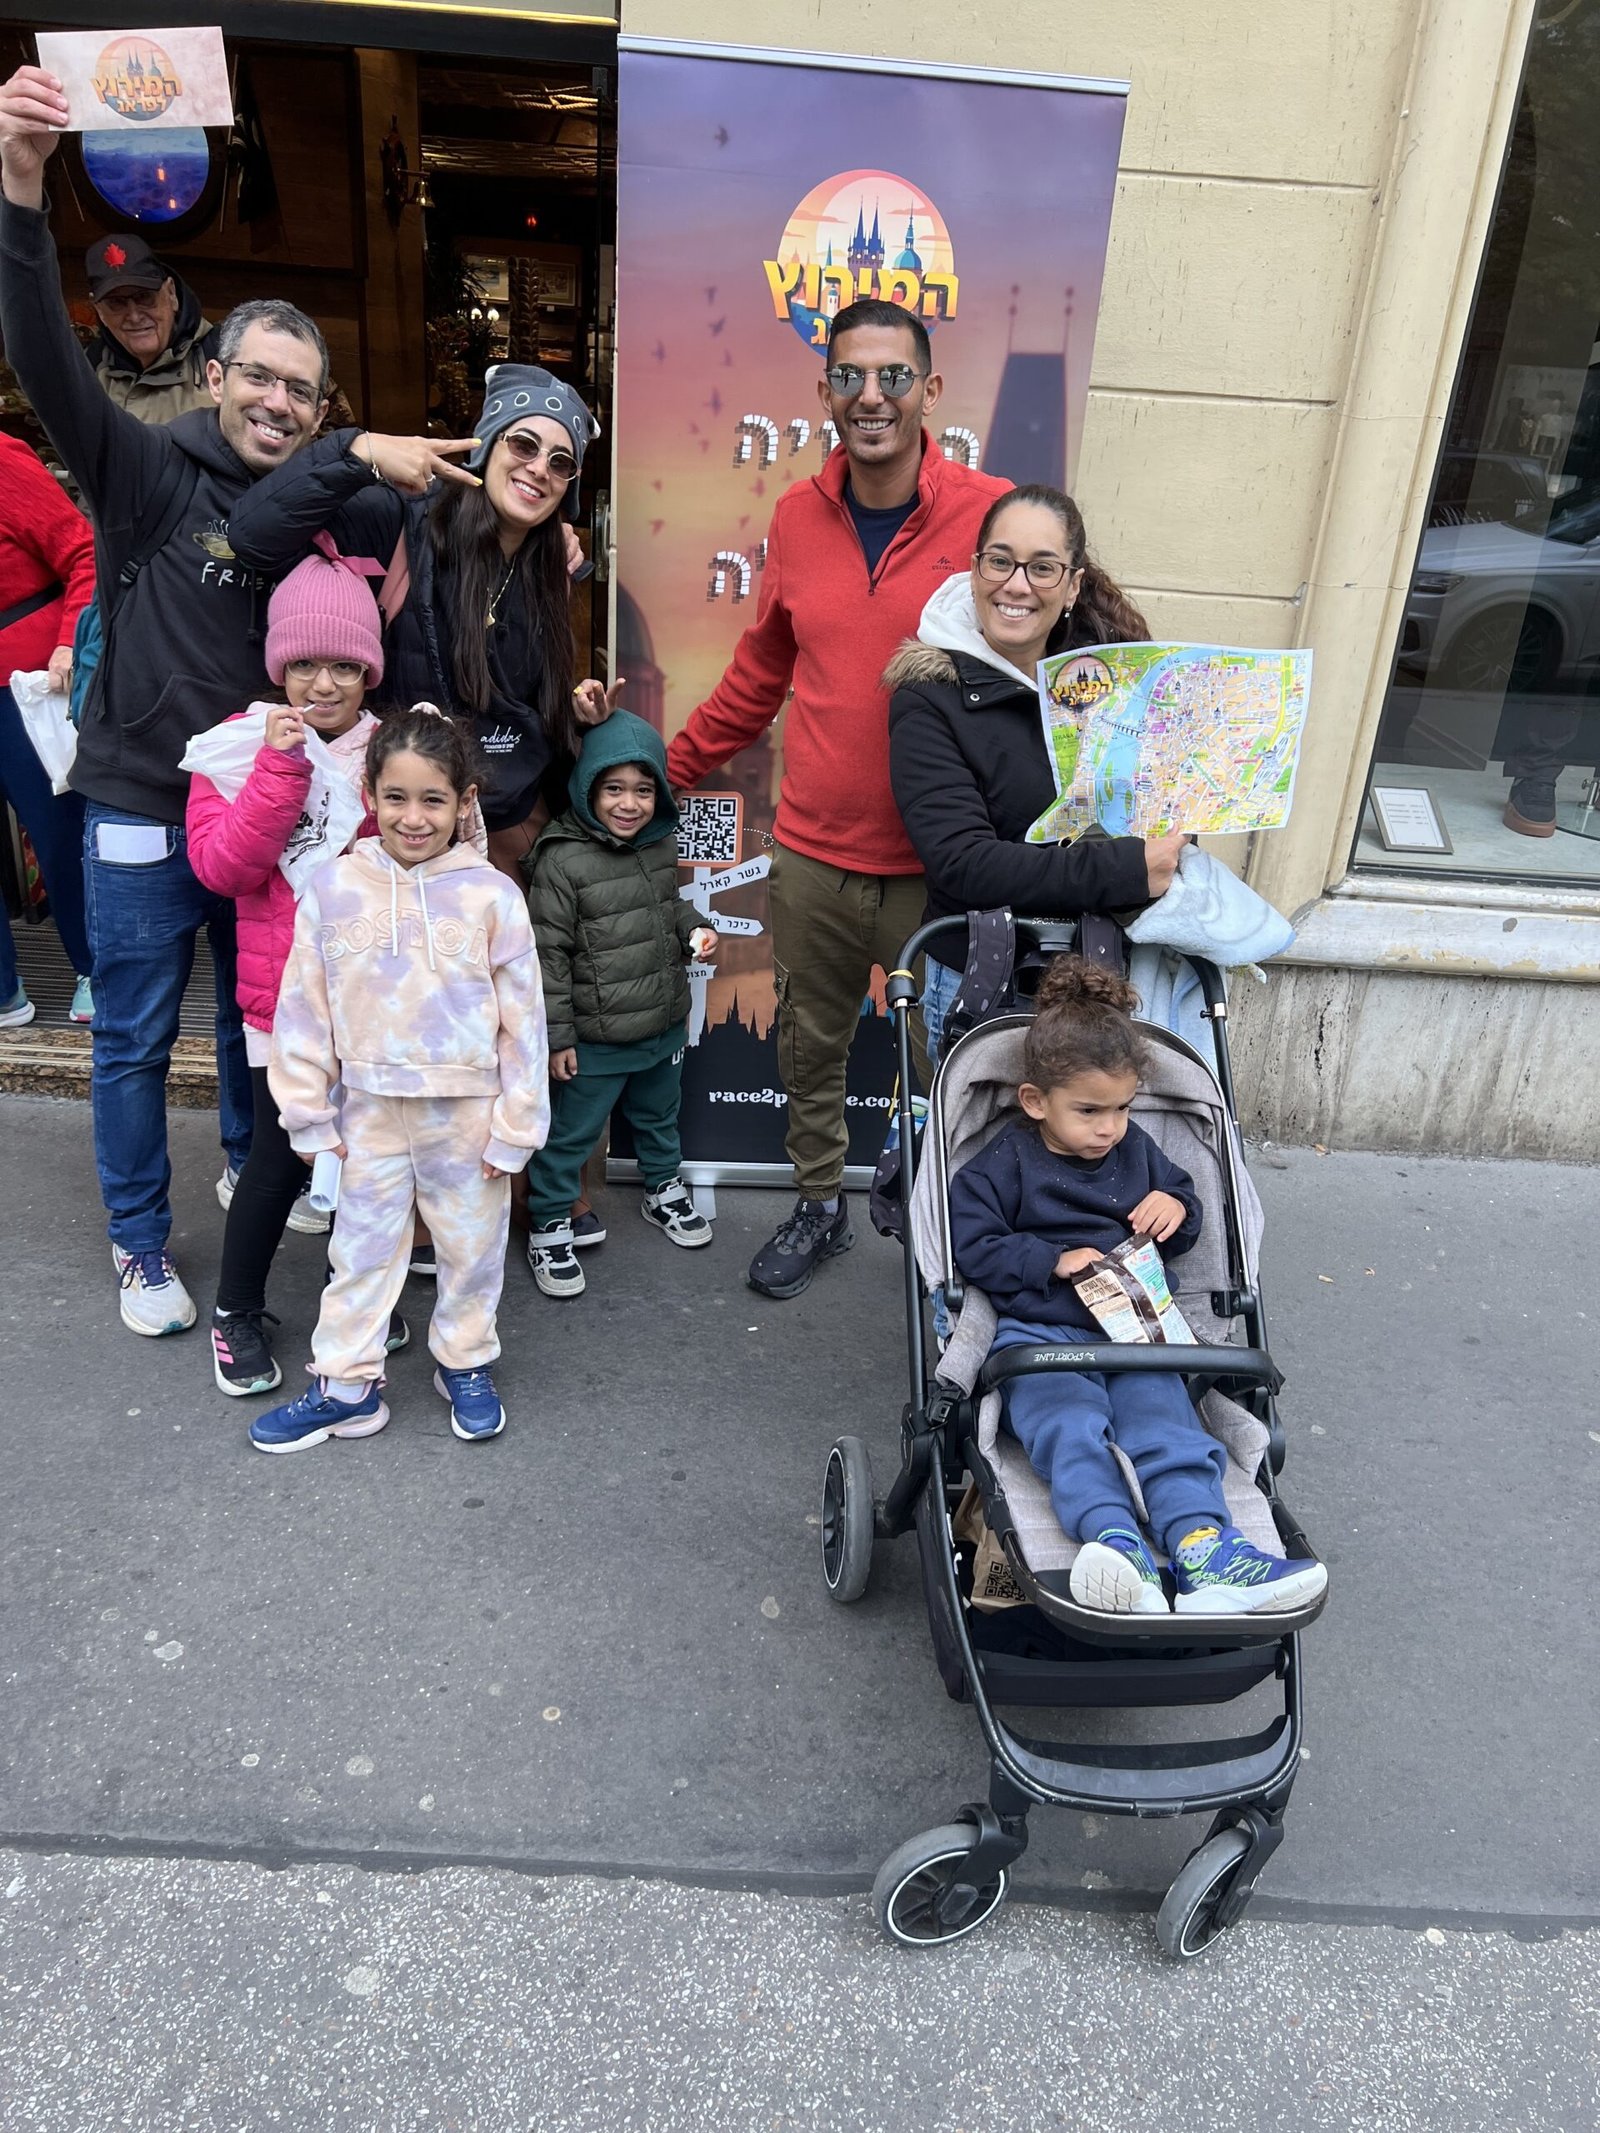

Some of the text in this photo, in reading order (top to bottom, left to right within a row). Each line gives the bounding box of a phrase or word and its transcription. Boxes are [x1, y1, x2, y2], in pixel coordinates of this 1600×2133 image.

[90, 76, 183, 104] המירוץ
[117, 96, 166, 113] לפראג
[763, 260, 959, 319] המירוץ
[1050, 680, 1114, 705] המירוץ
[480, 724, 522, 745] adidas
[700, 866, 761, 891] גשר קארל
[727, 920, 750, 930] כיכר
[1055, 1352, 1085, 1361] SPORT
